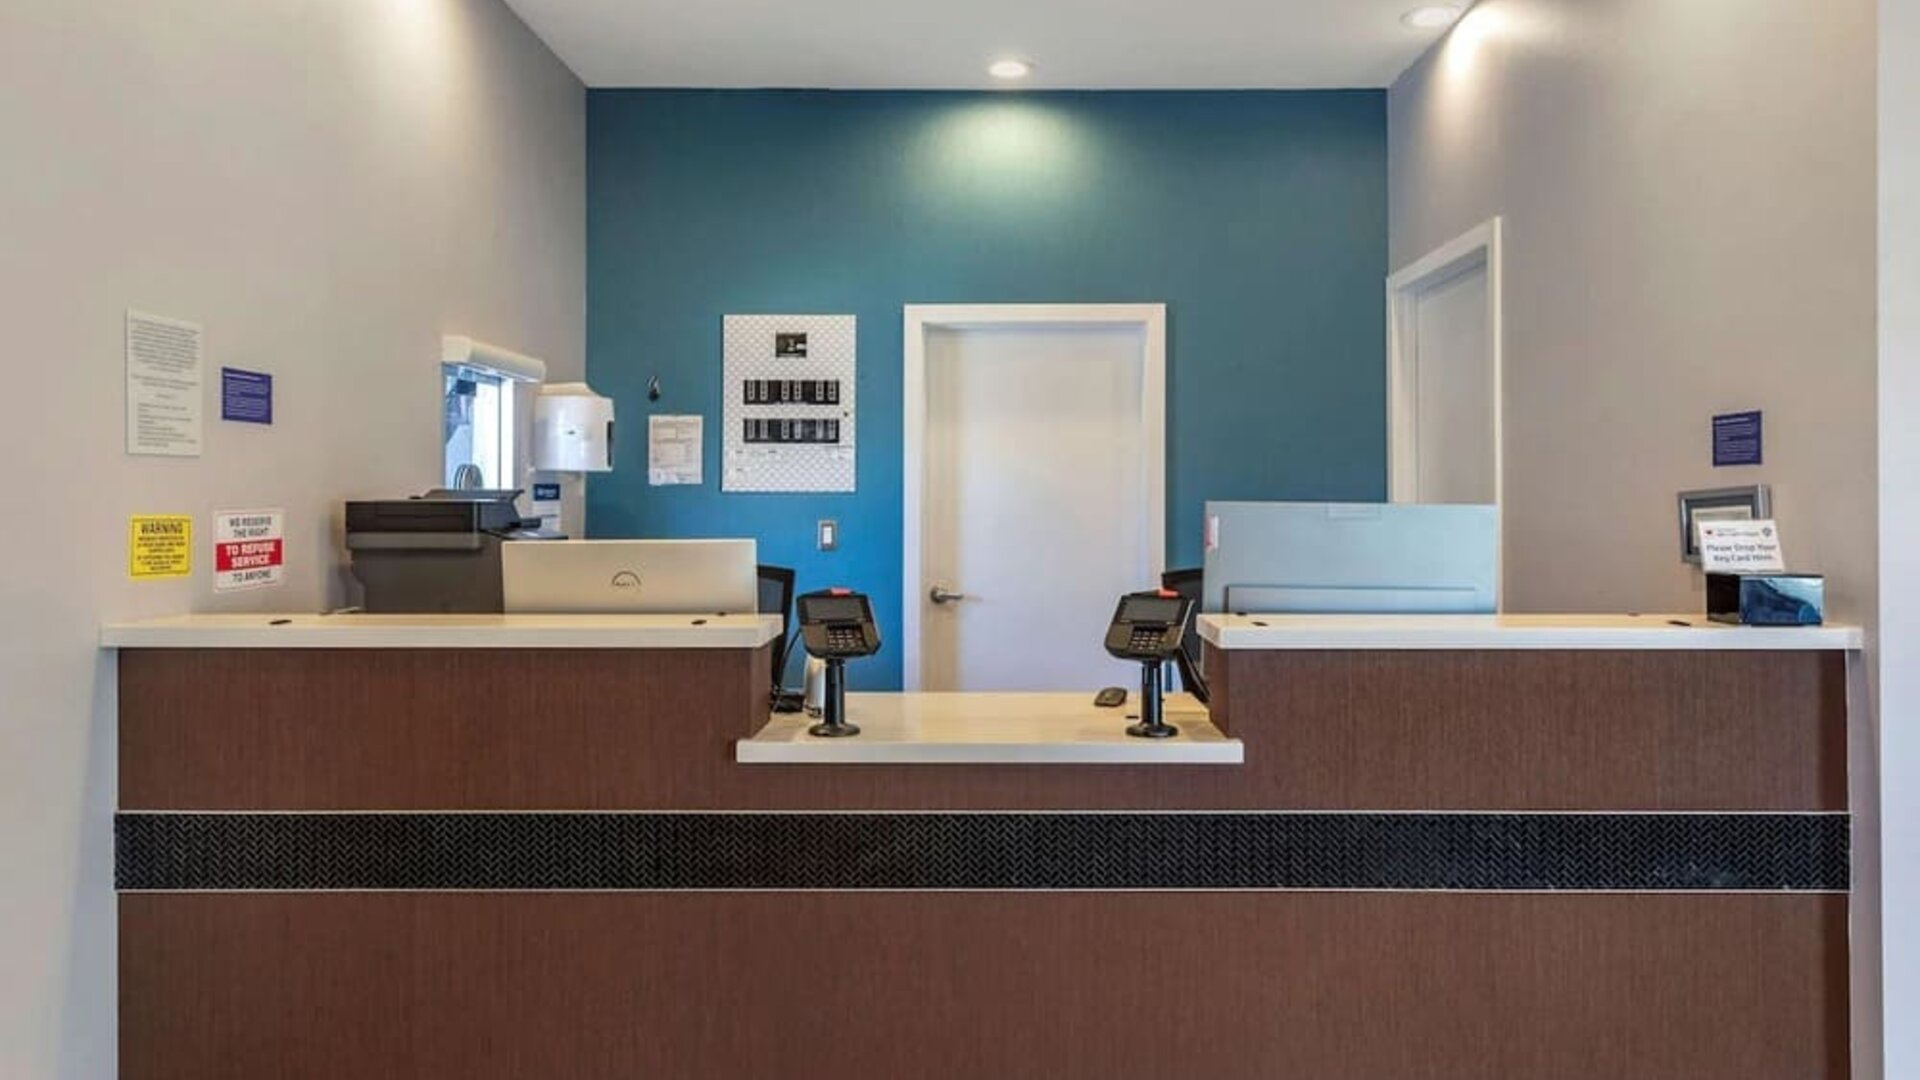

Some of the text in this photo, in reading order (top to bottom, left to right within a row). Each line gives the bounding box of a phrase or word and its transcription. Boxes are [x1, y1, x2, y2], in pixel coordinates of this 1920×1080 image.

[141, 523, 183, 534] WARNING
[233, 527, 269, 538] THE RIGHT
[225, 541, 275, 556] TO REFUSE
[230, 554, 271, 568] SERVICE
[1713, 554, 1730, 563] Key
[1731, 554, 1751, 562] Card
[232, 570, 272, 583] TO ANYONE
